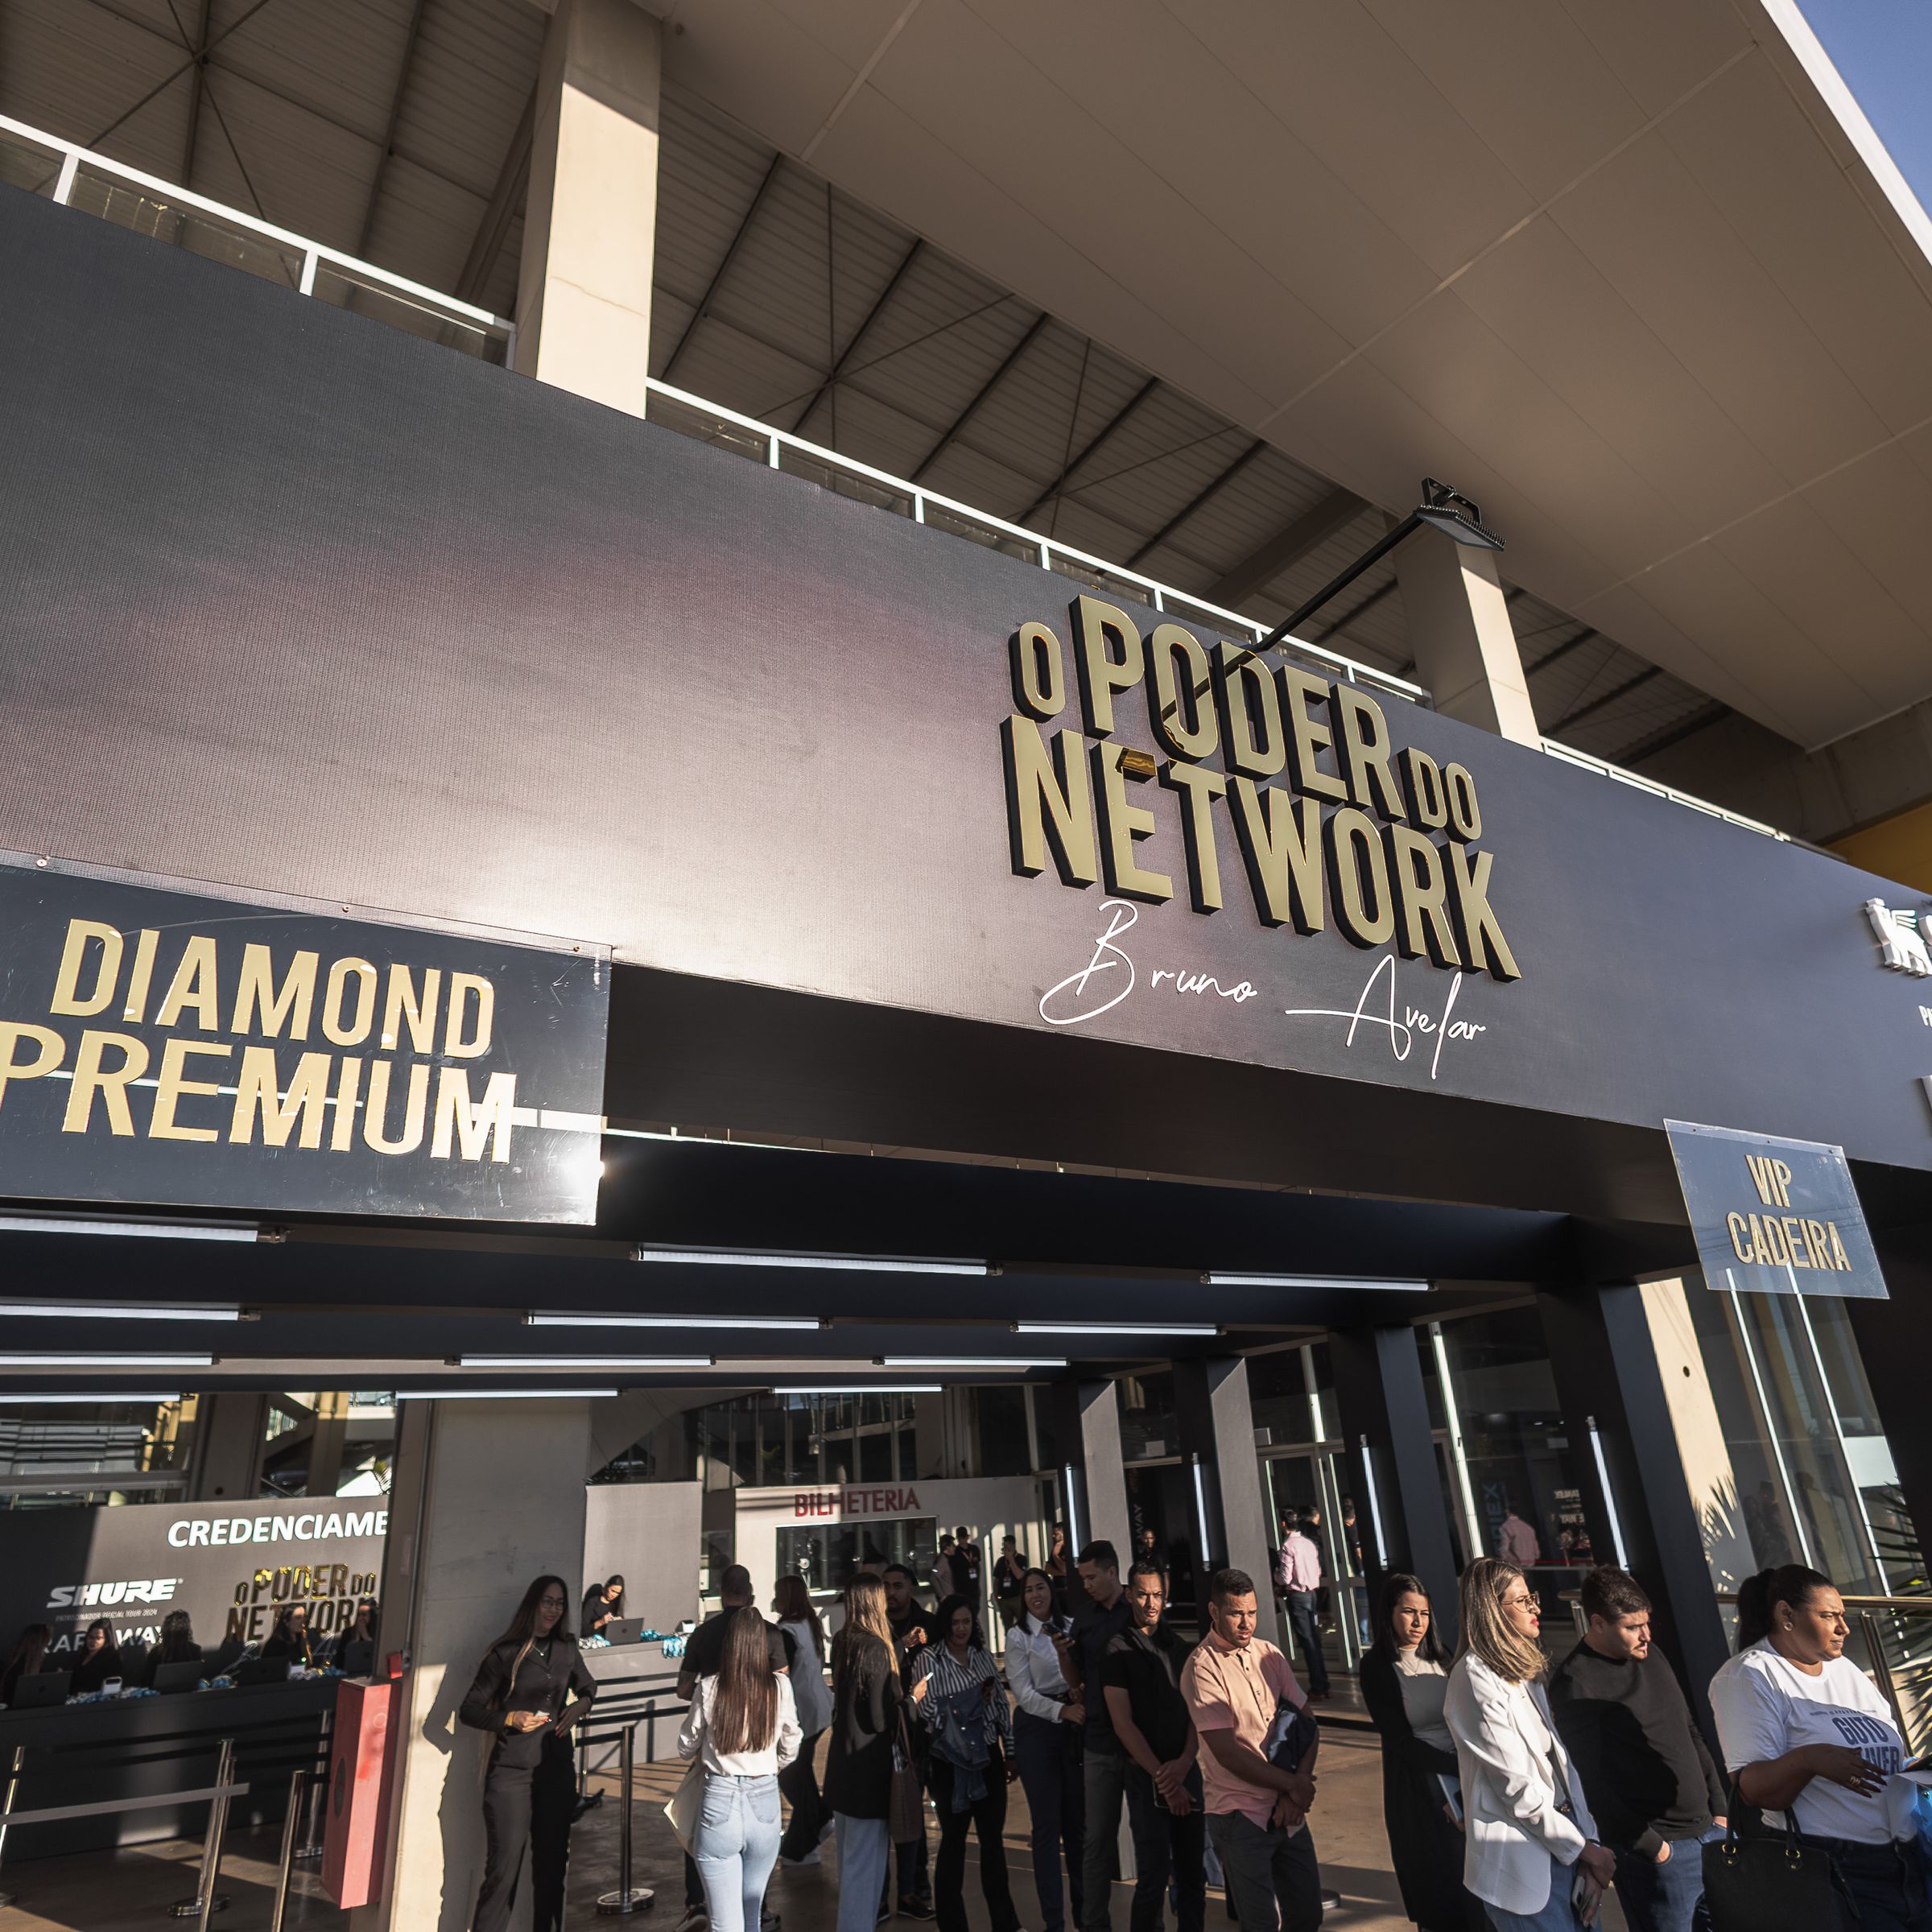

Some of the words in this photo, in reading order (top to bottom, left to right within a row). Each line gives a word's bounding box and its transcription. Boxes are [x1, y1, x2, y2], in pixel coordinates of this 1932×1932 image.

[1012, 621, 1067, 721] O
[1070, 594, 1406, 824] PODER
[1398, 746, 1482, 844] DO
[1001, 714, 1521, 982] NETWORK
[50, 919, 496, 1059] DIAMOND
[1039, 899, 1257, 1026] Bruno
[1286, 954, 1486, 1080] Avelar
[0, 1022, 517, 1165] PREMIUM
[1745, 1154, 1792, 1208] VIP
[1727, 1212, 1852, 1272] CADEIRA
[795, 1487, 921, 1517] BILHETERIA
[46, 1578, 178, 1608] SHURE
[233, 1581, 250, 1606] O
[251, 1563, 349, 1604] PODER
[351, 1572, 377, 1596] DO
[1831, 1715, 1889, 1745] GUTO
